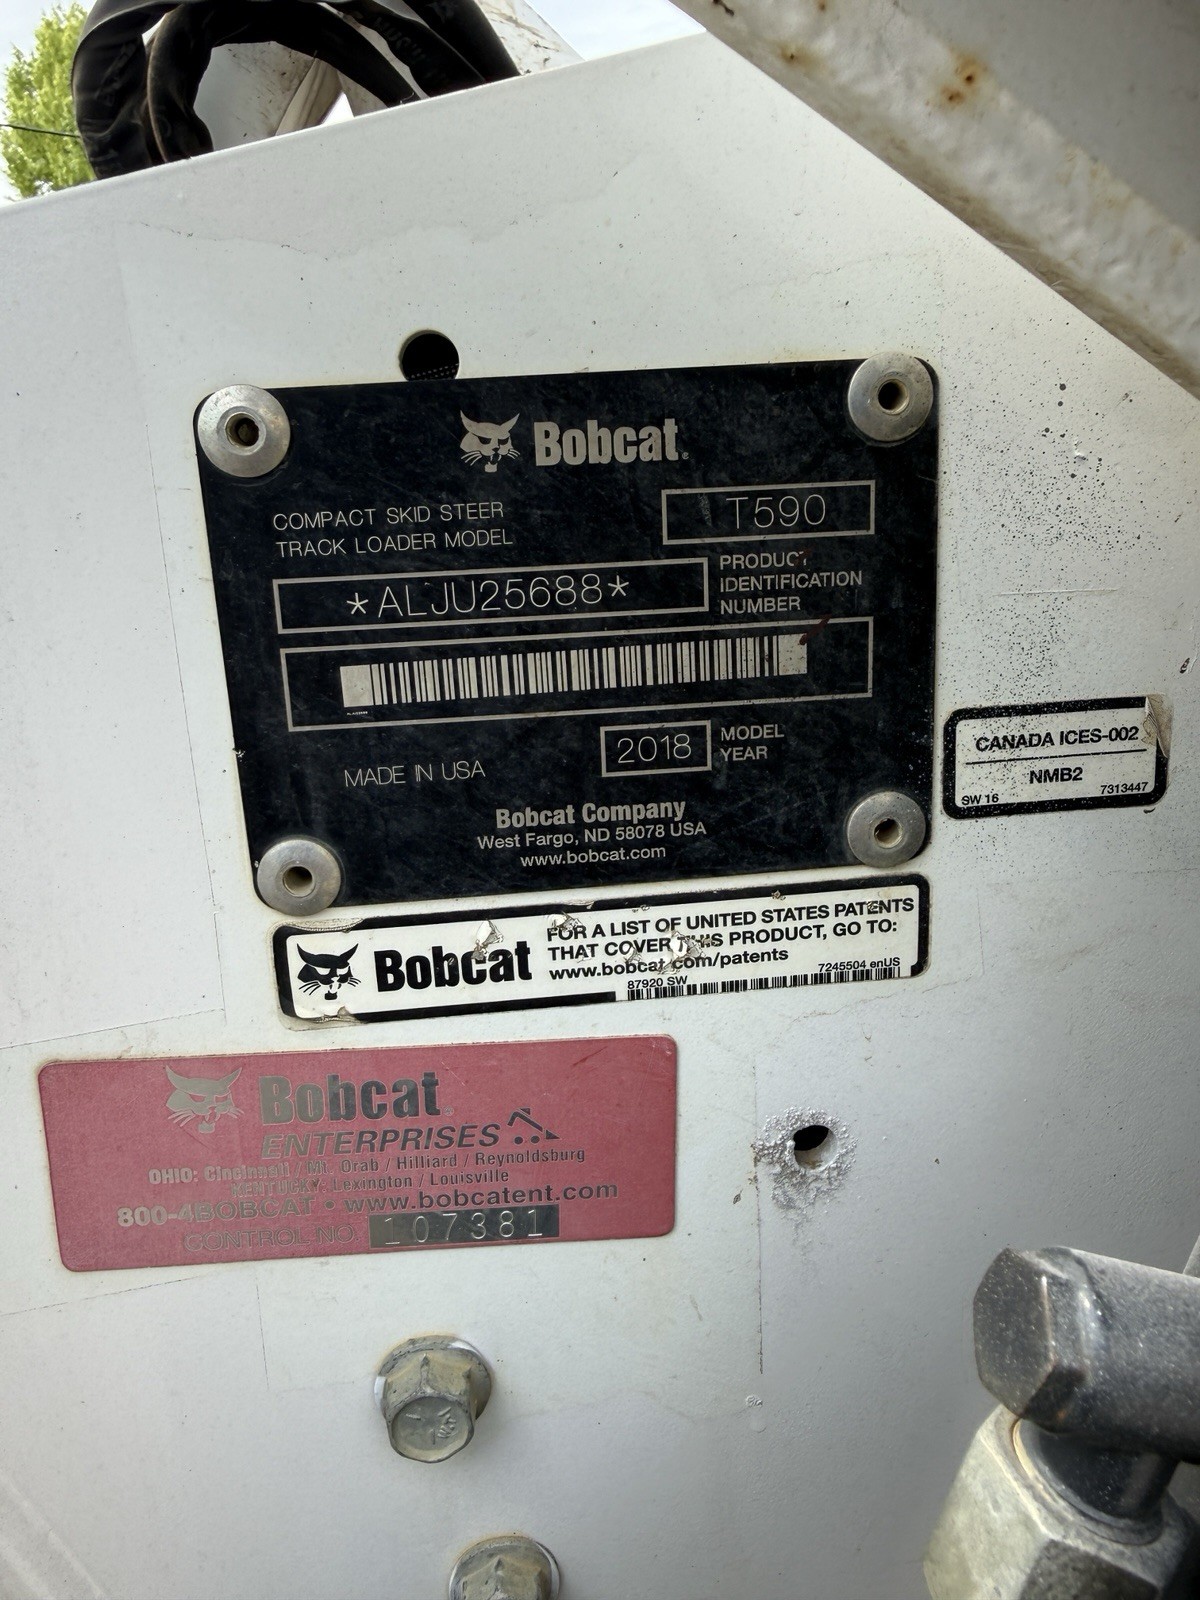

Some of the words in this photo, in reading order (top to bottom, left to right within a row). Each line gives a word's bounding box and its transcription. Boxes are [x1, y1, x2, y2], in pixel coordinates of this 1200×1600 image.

[533, 418, 678, 466] Bobcat
[273, 508, 376, 531] COMPACT
[387, 506, 431, 525] SKID
[440, 502, 504, 521] STEER
[726, 494, 826, 529] T590
[276, 538, 346, 558] TRACK
[356, 533, 436, 553] LOADER
[445, 529, 512, 548] MODEL
[720, 570, 862, 592] IDENTIFICATION
[720, 596, 801, 615] NUMBER
[721, 724, 785, 741] MODEL
[976, 731, 1055, 751] CANADA
[1060, 726, 1139, 745] ICES-002
[617, 734, 692, 764] 2018
[720, 746, 768, 762] YEAR
[344, 765, 406, 787] MADE
[415, 764, 432, 782] IN
[442, 761, 486, 780] USA
[1029, 767, 1083, 784] NMB2
[1100, 782, 1149, 795] 7313447
[962, 795, 982, 805] SW
[986, 794, 999, 803] 16
[495, 804, 575, 829] Bobcat
[582, 801, 686, 824] Company
[477, 834, 520, 850] West
[525, 830, 579, 849] Fargo,
[585, 827, 610, 842] ND
[616, 824, 665, 841] 58078
[670, 822, 707, 836] USA
[520, 845, 666, 867] www.bobcat.com
[547, 925, 587, 941] FOR
[591, 923, 606, 937] A
[610, 919, 651, 936] LIST
[655, 917, 682, 932] OF
[685, 911, 757, 930] UNITED
[761, 905, 830, 923] STATES
[834, 897, 914, 917] PATENTS
[548, 944, 597, 962] THAT
[605, 938, 671, 955] COVER
[729, 924, 827, 947] PRODUCT,
[832, 920, 861, 935] GO
[866, 919, 897, 933] TO:
[374, 940, 532, 992] Bobcat
[549, 948, 788, 980] www.bobcatcom/patents
[818, 959, 867, 973] 7245504
[870, 957, 900, 969] enUS
[627, 978, 663, 989] 87920
[667, 976, 688, 987] SW
[259, 1072, 440, 1126] Bobcat
[261, 1122, 501, 1159] ENTERPRISES
[148, 1167, 198, 1185] OHIO:
[204, 1162, 289, 1181] Cincinnati
[307, 1160, 334, 1175] Mt.
[341, 1159, 379, 1173] Orab
[397, 1153, 458, 1169] Hilliard
[475, 1148, 585, 1166] Reynoldsburg
[231, 1179, 327, 1198] KENTUCKY:
[333, 1174, 412, 1191] Lexington
[430, 1169, 509, 1186] Louisville
[117, 1197, 316, 1227] 800-4BOBCAT
[344, 1182, 618, 1213] www.bobcatent.com
[184, 1225, 310, 1252] CONTROL
[316, 1223, 359, 1243] NO.
[385, 1208, 543, 1245] 107381
